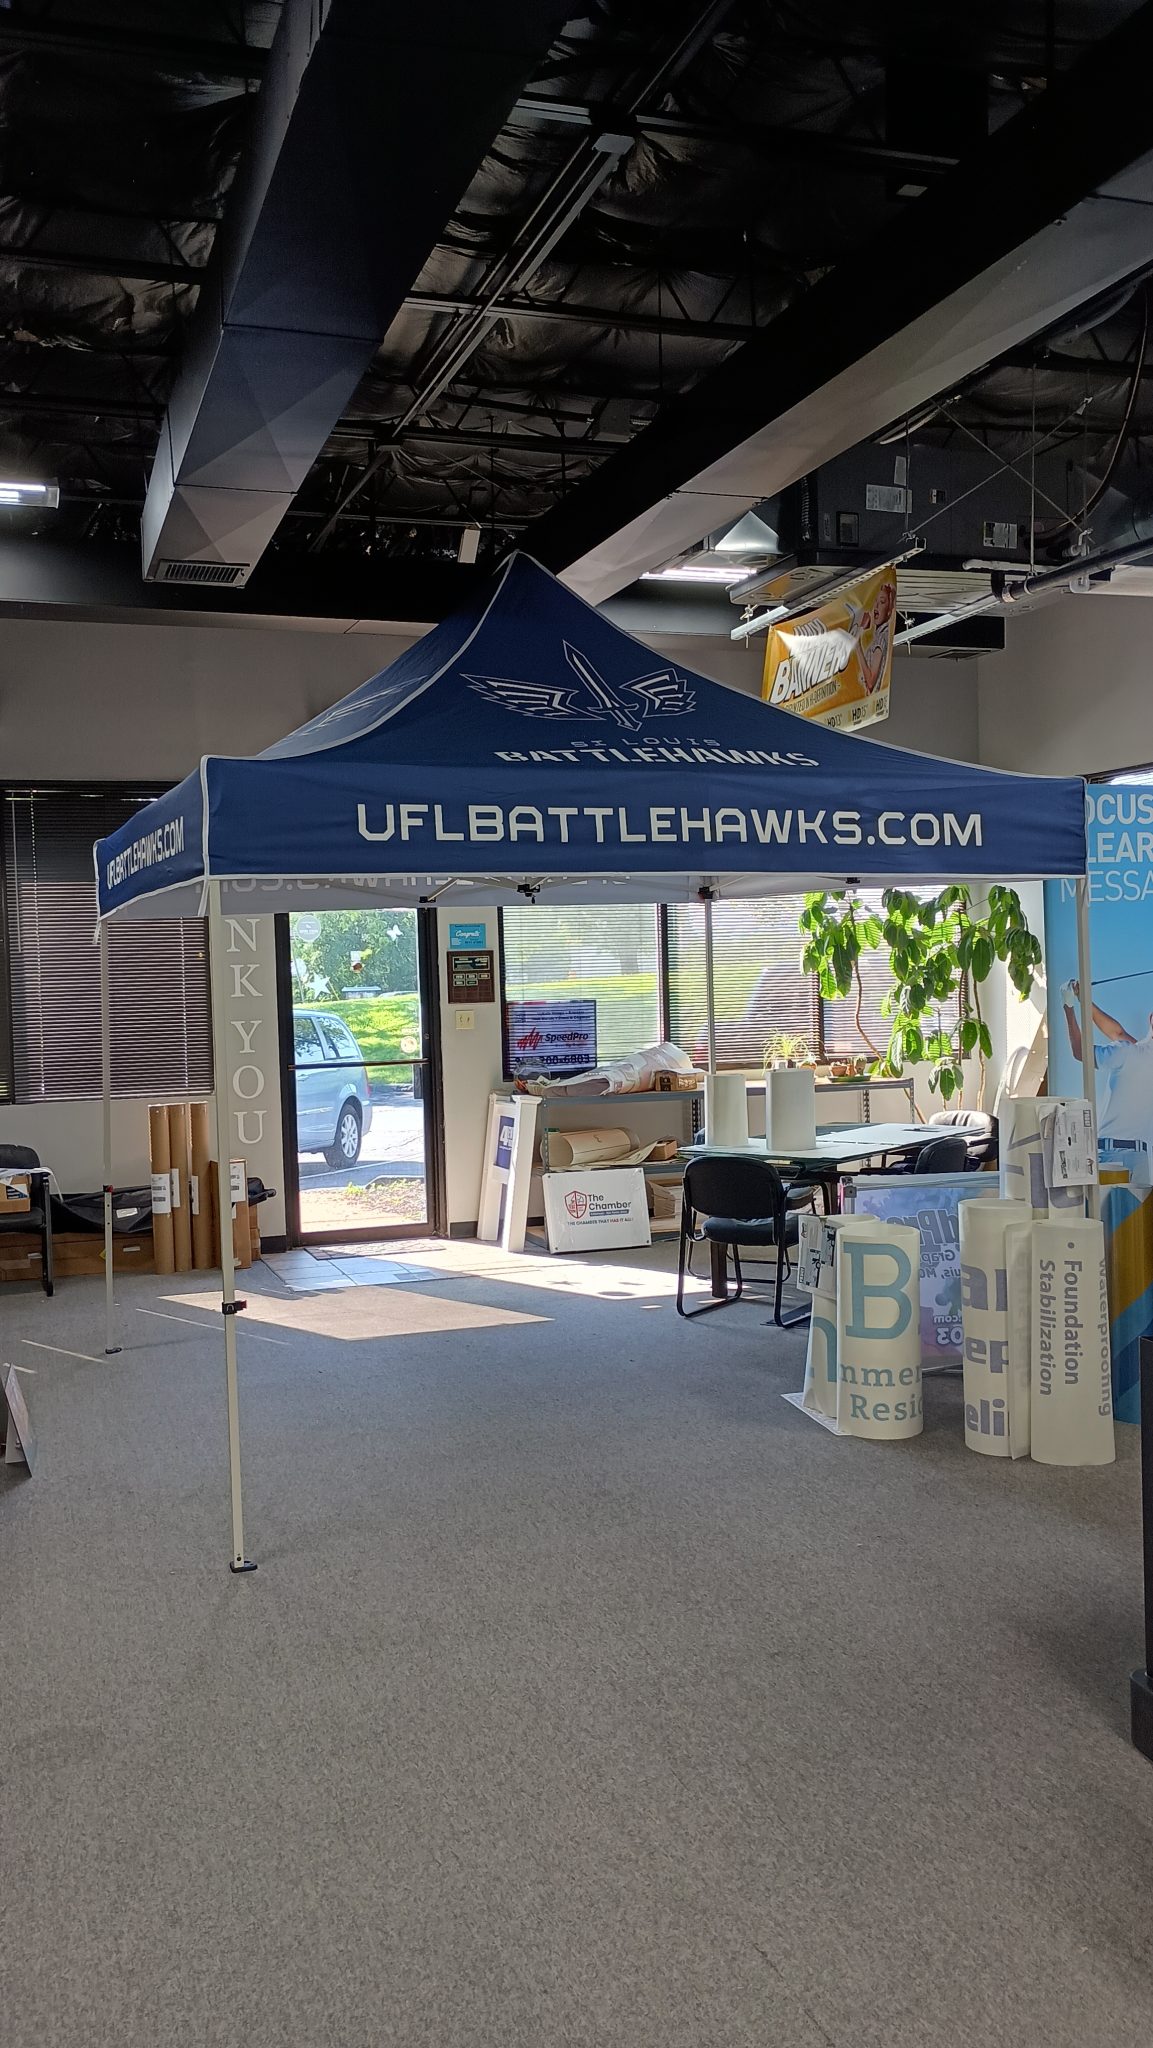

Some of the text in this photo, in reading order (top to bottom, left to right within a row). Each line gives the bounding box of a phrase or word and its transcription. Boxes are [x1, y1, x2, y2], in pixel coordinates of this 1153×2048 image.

[494, 747, 820, 767] BATTLEHAWKS
[621, 737, 721, 747] LOUIS
[357, 803, 983, 846] UFLBATTLEHAWKS.COM
[106, 816, 185, 890] UFLBATTLEHAWKS.COM
[544, 1032, 590, 1043] SpeedPro
[230, 1020, 268, 1144] YOU
[587, 1193, 605, 1202] The
[588, 1200, 632, 1211] Chamber
[1040, 1259, 1056, 1395] Stabilization
[1063, 1260, 1083, 1385] Foundation
